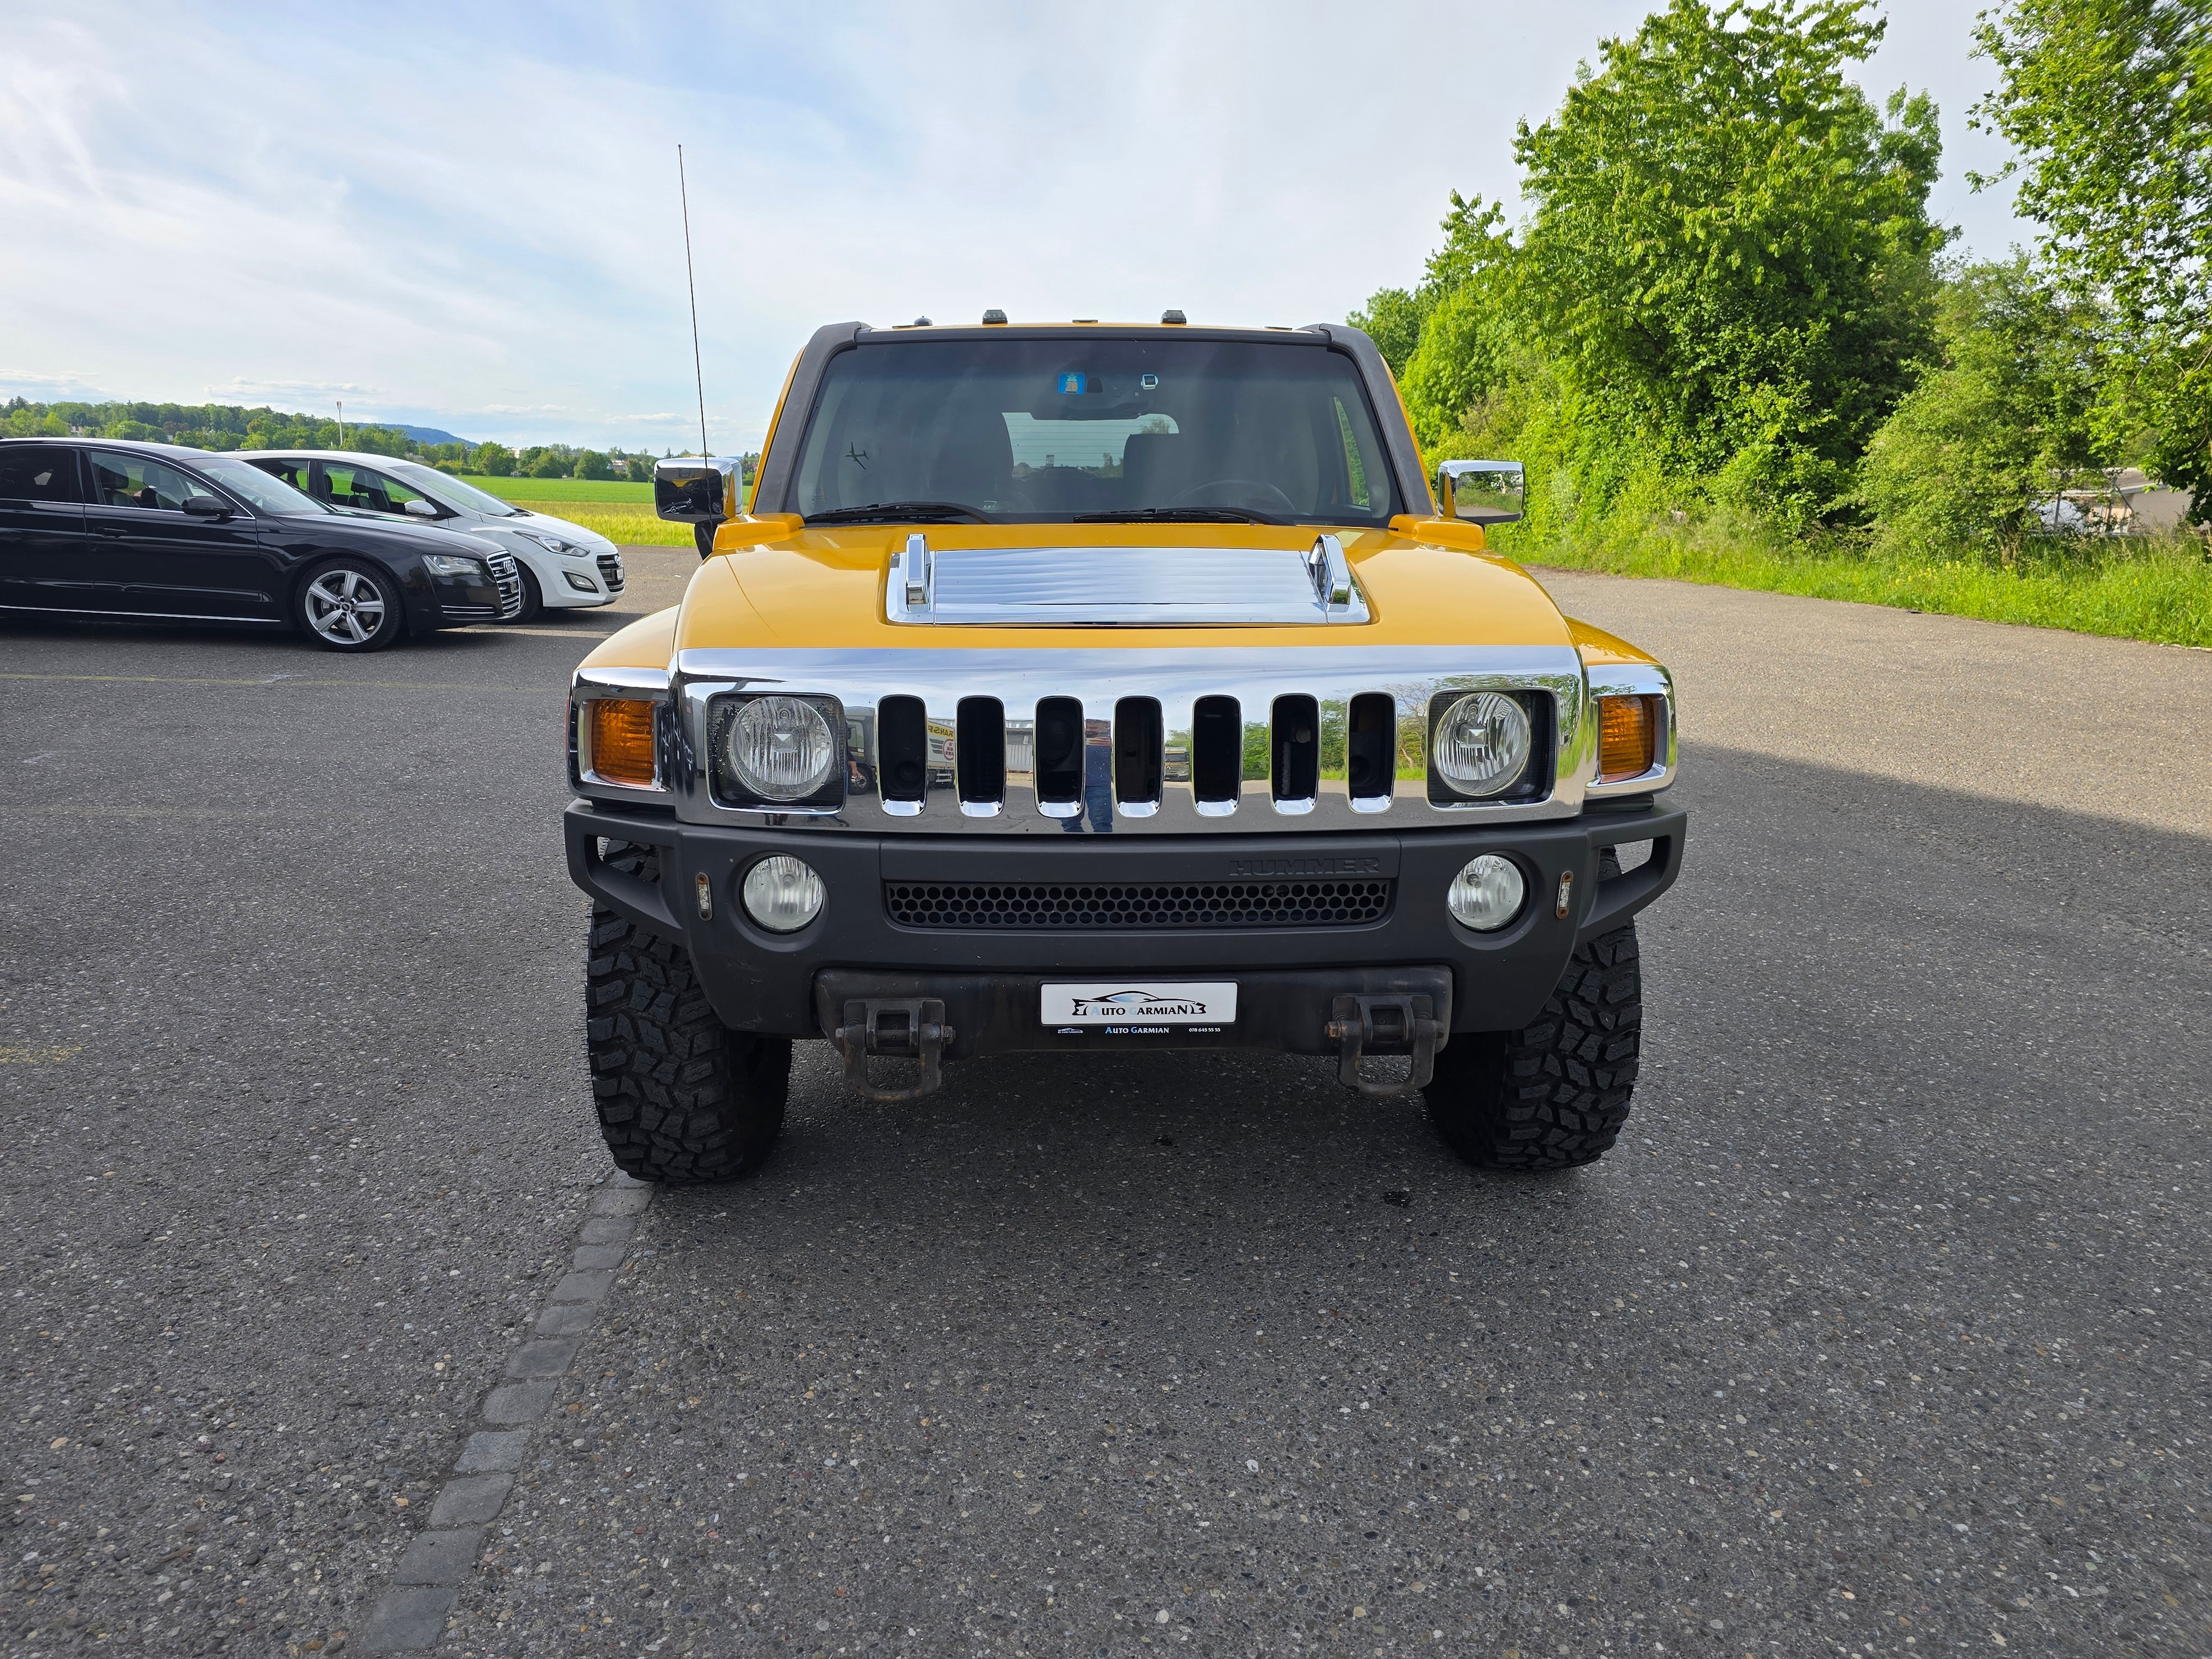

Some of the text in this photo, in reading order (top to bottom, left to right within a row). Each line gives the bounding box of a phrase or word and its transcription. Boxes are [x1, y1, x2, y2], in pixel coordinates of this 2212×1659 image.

[1229, 857, 1380, 876] HUMMER
[1091, 1004, 1187, 1016] AUTO GARMIAN
